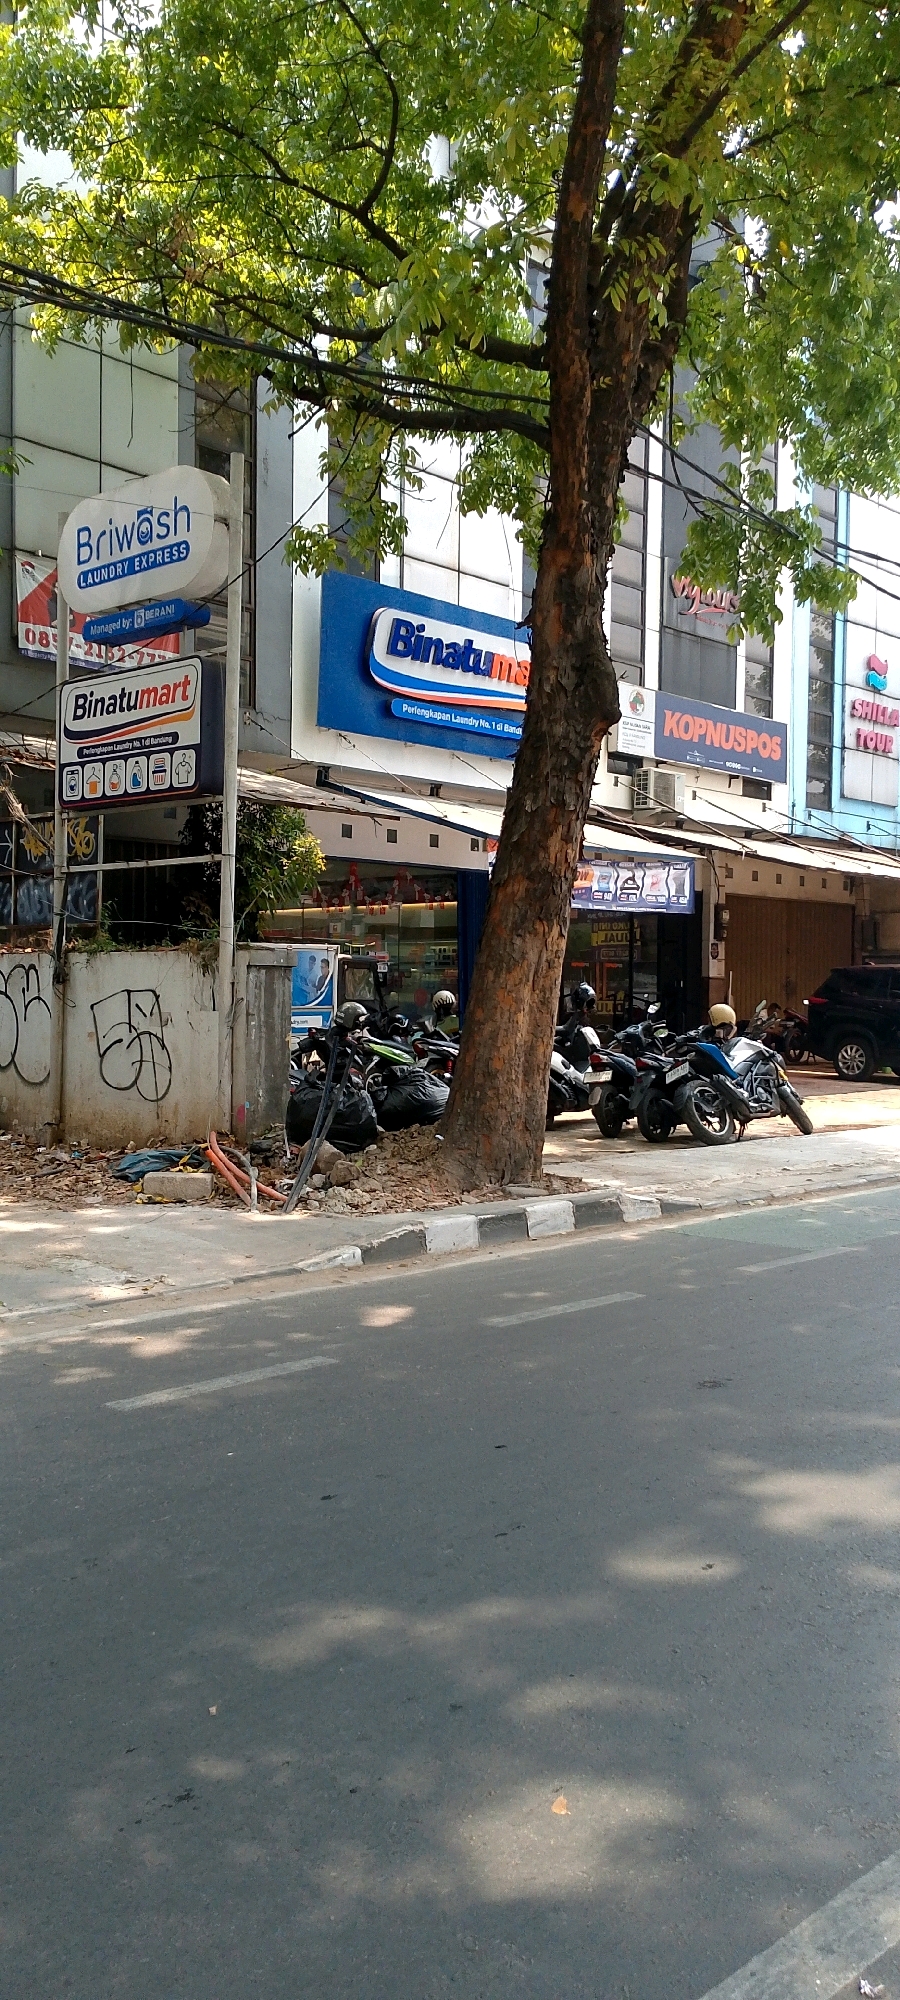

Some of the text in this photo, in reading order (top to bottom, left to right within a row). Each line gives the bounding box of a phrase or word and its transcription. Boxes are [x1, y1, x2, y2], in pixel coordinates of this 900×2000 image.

[77, 496, 191, 566] Briwash
[80, 543, 187, 588] LAUNDRY EXPRESS
[90, 604, 175, 636] Managed by: BERANI
[72, 674, 191, 721] Binatumart
[851, 698, 900, 727] SHILLA
[402, 703, 451, 722] Perlengkapan
[451, 713, 479, 728] Laundry
[479, 719, 491, 729] No.
[496, 722, 503, 731] di
[83, 744, 113, 755] Perlengkapan
[114, 741, 132, 751] Laundry
[133, 739, 141, 748] No.
[150, 735, 173, 745] Bandung
[663, 709, 782, 761] KOPNUSPOS
[856, 727, 894, 754] TOUR
